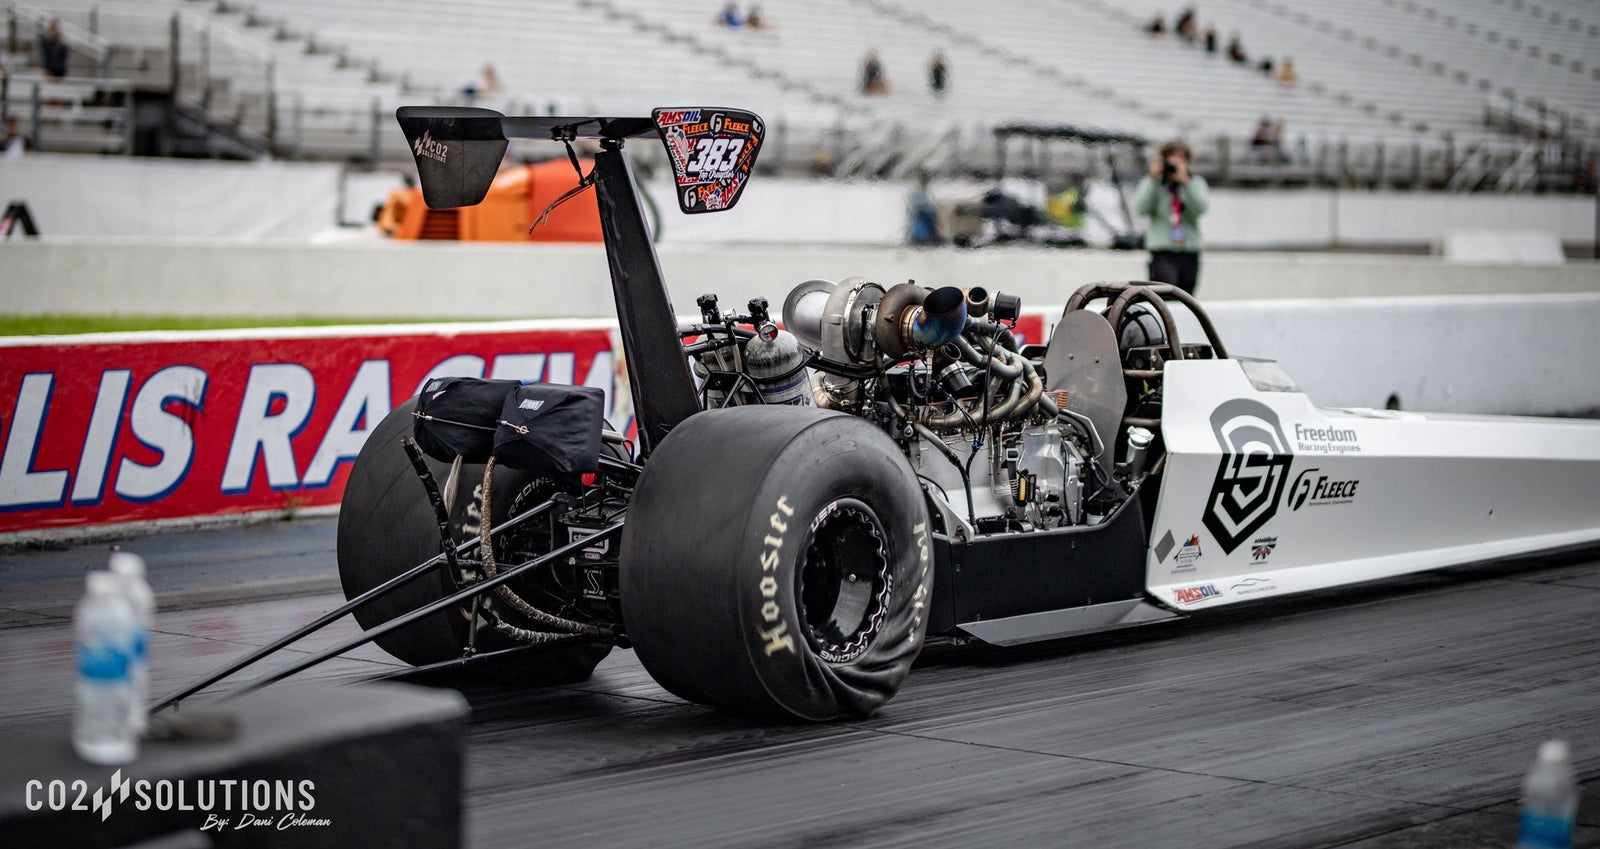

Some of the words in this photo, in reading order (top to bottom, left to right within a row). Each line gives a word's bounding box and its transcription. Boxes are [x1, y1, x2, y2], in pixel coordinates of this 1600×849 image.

[658, 111, 699, 126] AMSOIL
[724, 118, 750, 132] FLEECE
[682, 123, 709, 134] FLEECE
[421, 149, 446, 163] SOLUTIONS
[430, 141, 448, 157] CO2
[687, 138, 745, 173] 383
[0, 365, 208, 511] LIS
[1295, 423, 1357, 441] Freedom
[1298, 442, 1328, 453] Racing
[1327, 443, 1361, 453] Engines
[1311, 475, 1359, 499] FLEECE
[811, 501, 838, 532] USA
[759, 496, 795, 658] Hoosier
[1174, 585, 1220, 602] AMSOIL
[819, 640, 868, 662] RACING
